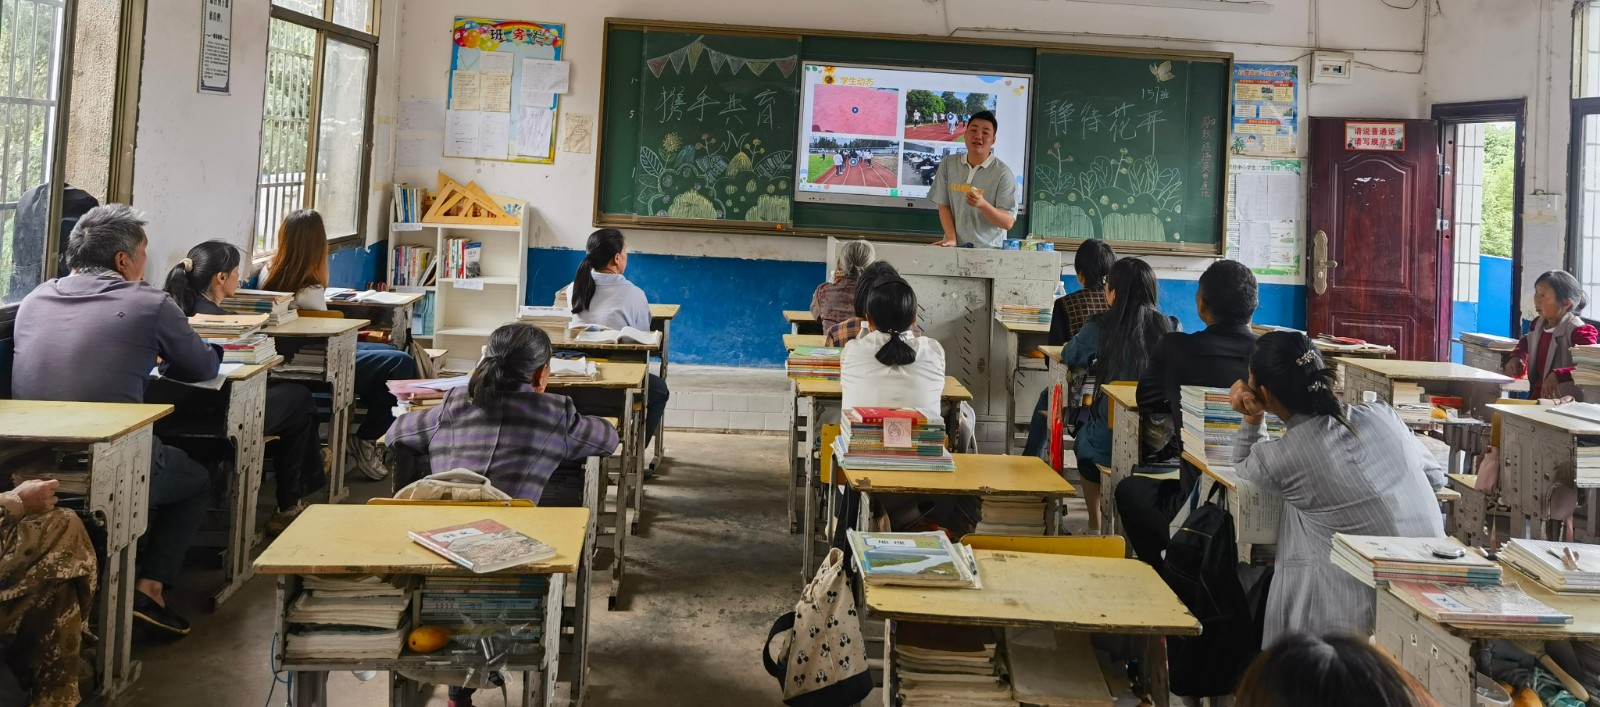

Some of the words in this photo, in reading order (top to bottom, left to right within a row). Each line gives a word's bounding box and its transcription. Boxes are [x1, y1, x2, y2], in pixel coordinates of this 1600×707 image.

[490, 28, 546, 44] 班务栏
[840, 76, 875, 87] 学生动态
[655, 86, 778, 131] 携手共育
[1044, 98, 1168, 152] 静待花开
[1354, 127, 1395, 135] 请说普通话
[1354, 138, 1395, 146] 请写规范字
